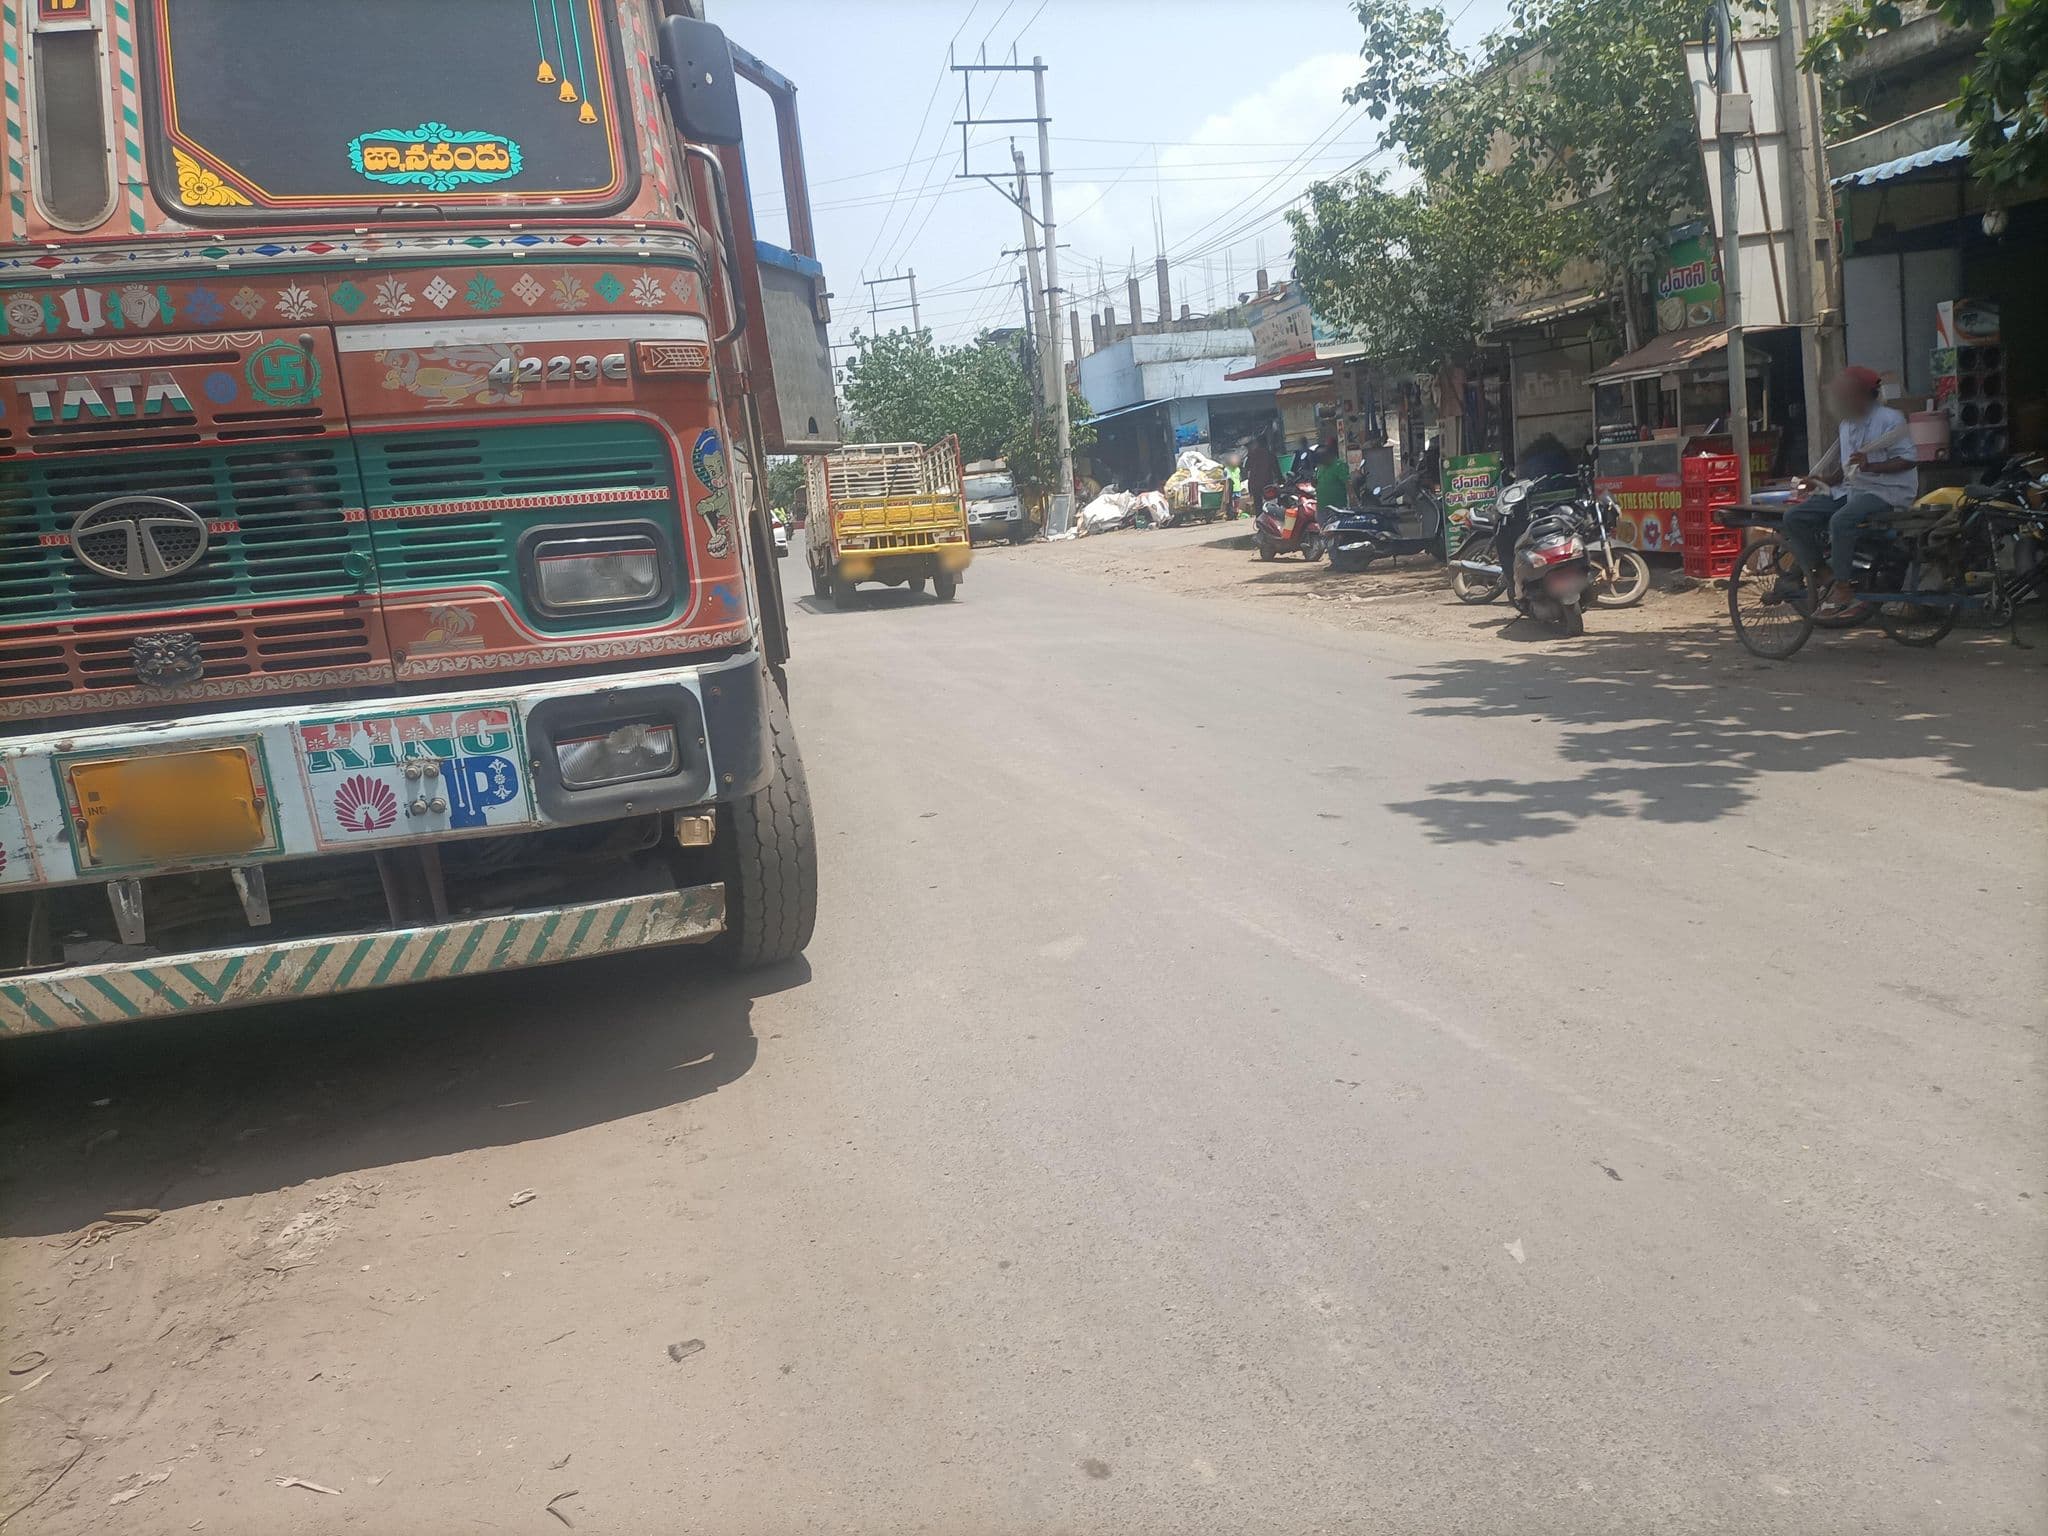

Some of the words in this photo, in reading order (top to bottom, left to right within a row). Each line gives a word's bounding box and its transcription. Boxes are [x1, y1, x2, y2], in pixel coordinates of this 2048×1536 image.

[1659, 260, 1707, 298] భవాని
[15, 371, 193, 422] TATA
[1451, 473, 1490, 492] భవాని
[1639, 491, 1659, 510] FAST
[1660, 490, 1682, 510] FOOD
[300, 709, 514, 774] KING
